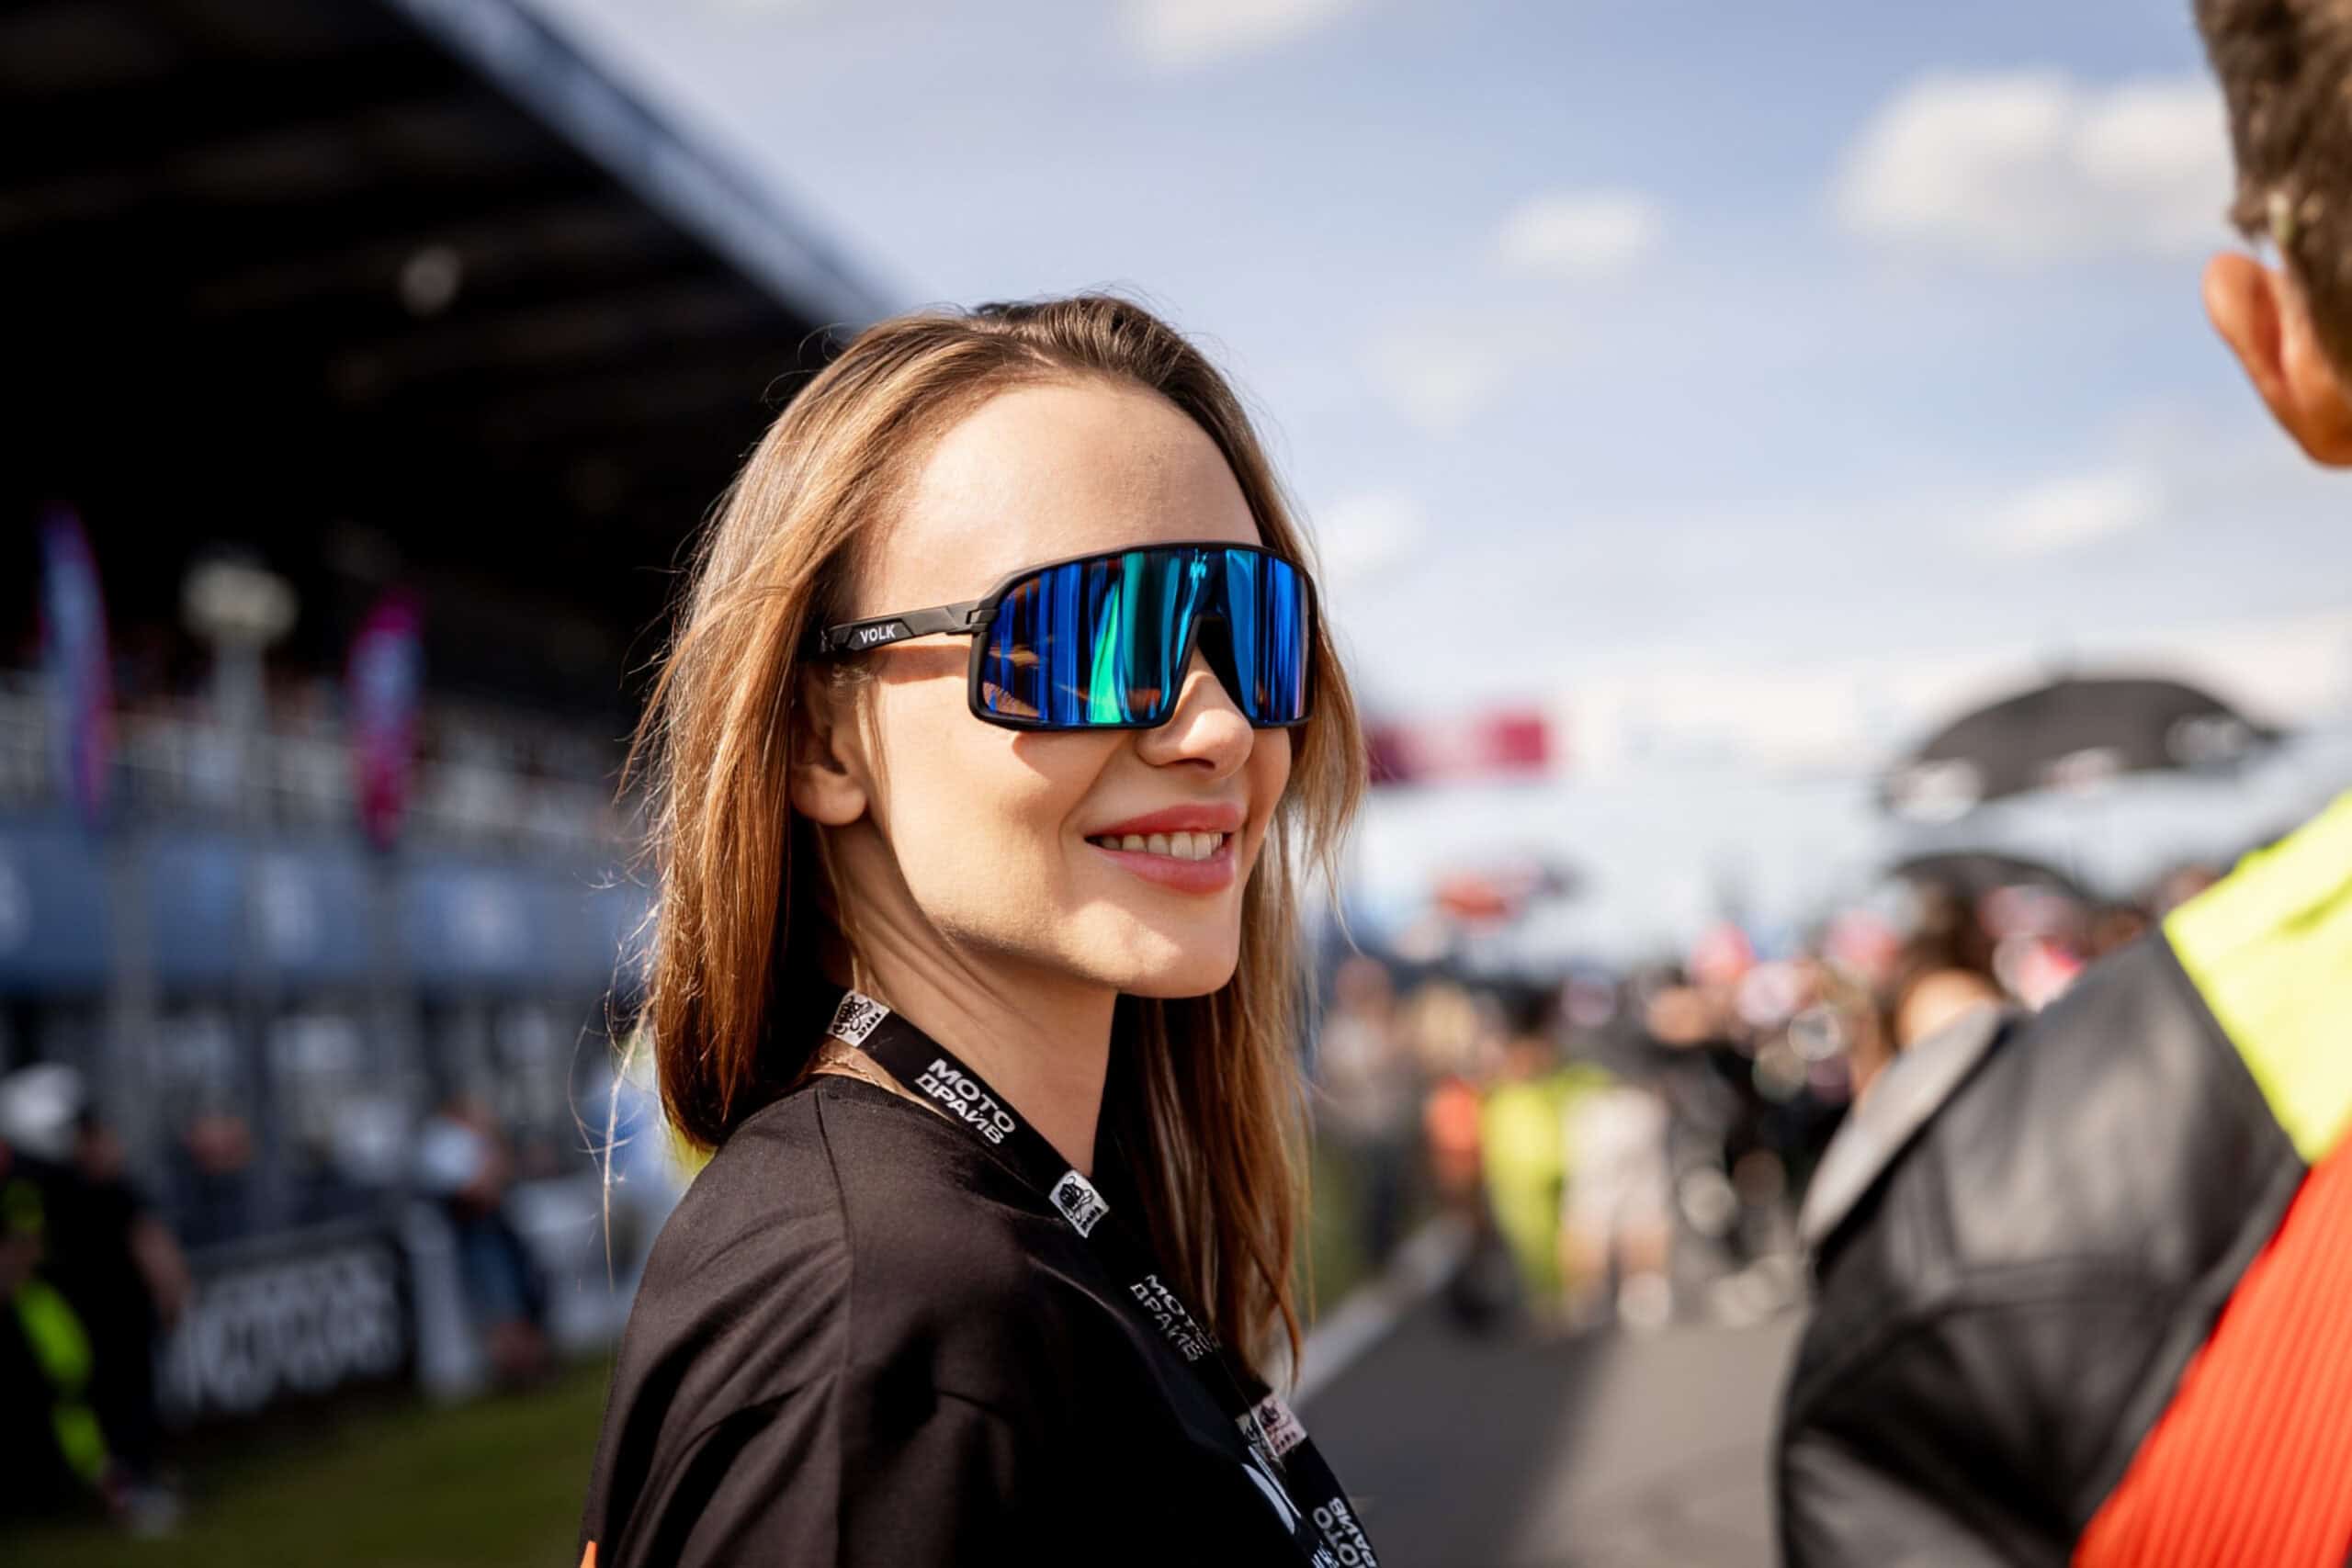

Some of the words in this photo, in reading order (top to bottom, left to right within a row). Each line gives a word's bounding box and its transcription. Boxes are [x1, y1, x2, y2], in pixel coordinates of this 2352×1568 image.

[859, 624, 896, 643] VOLK
[914, 1072, 1005, 1145] ДРАЙВ
[927, 1058, 1016, 1133] МОТО
[1312, 1506, 1368, 1568] ОТО
